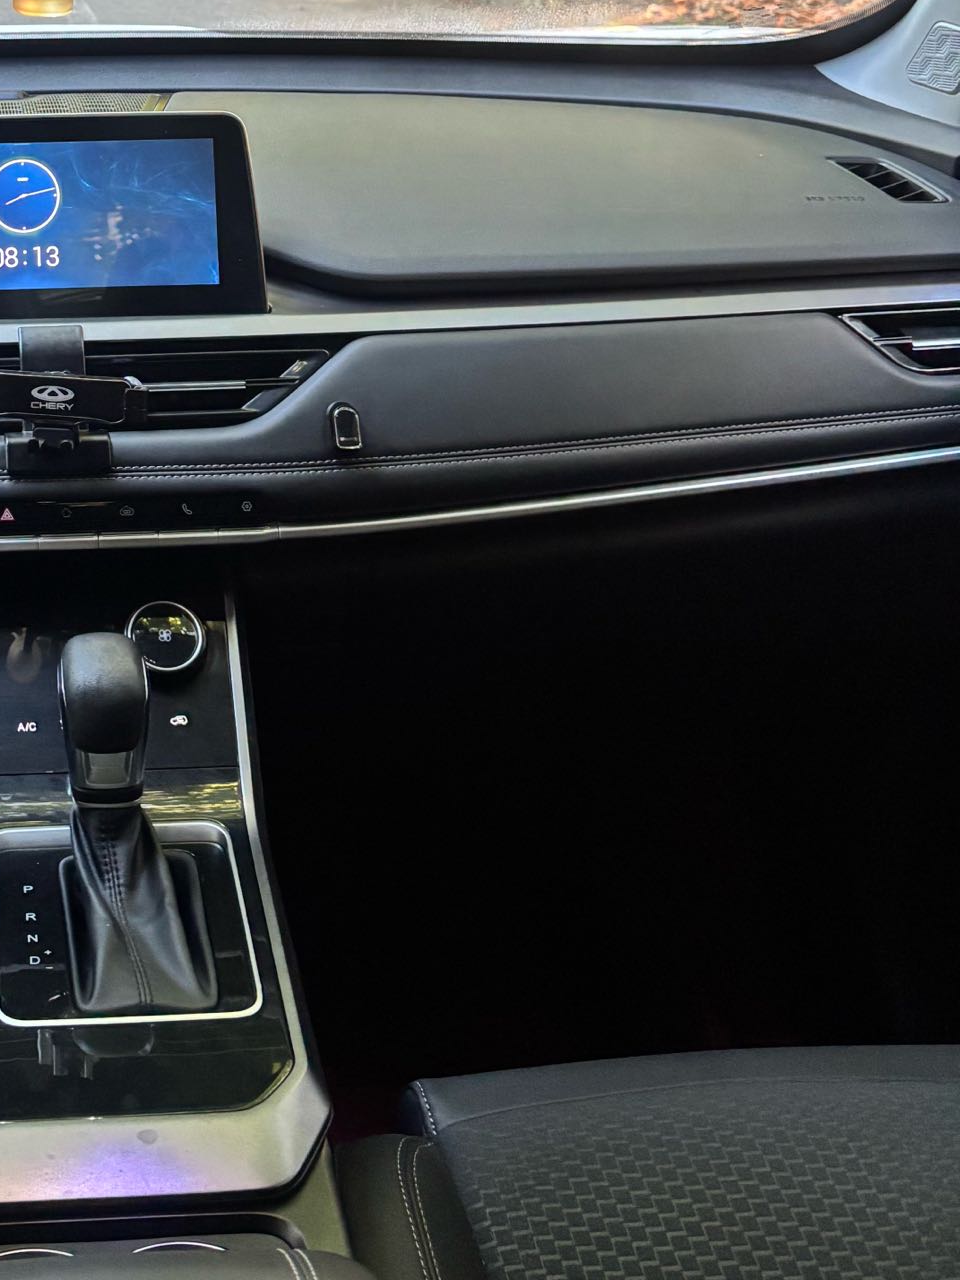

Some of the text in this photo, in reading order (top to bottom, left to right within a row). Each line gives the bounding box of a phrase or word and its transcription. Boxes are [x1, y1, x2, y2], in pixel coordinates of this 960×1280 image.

[30, 401, 74, 411] CHERY
[17, 721, 37, 732] A/C
[23, 885, 34, 894] P
[25, 912, 37, 922] R
[27, 934, 39, 943] N
[29, 955, 41, 965] D
